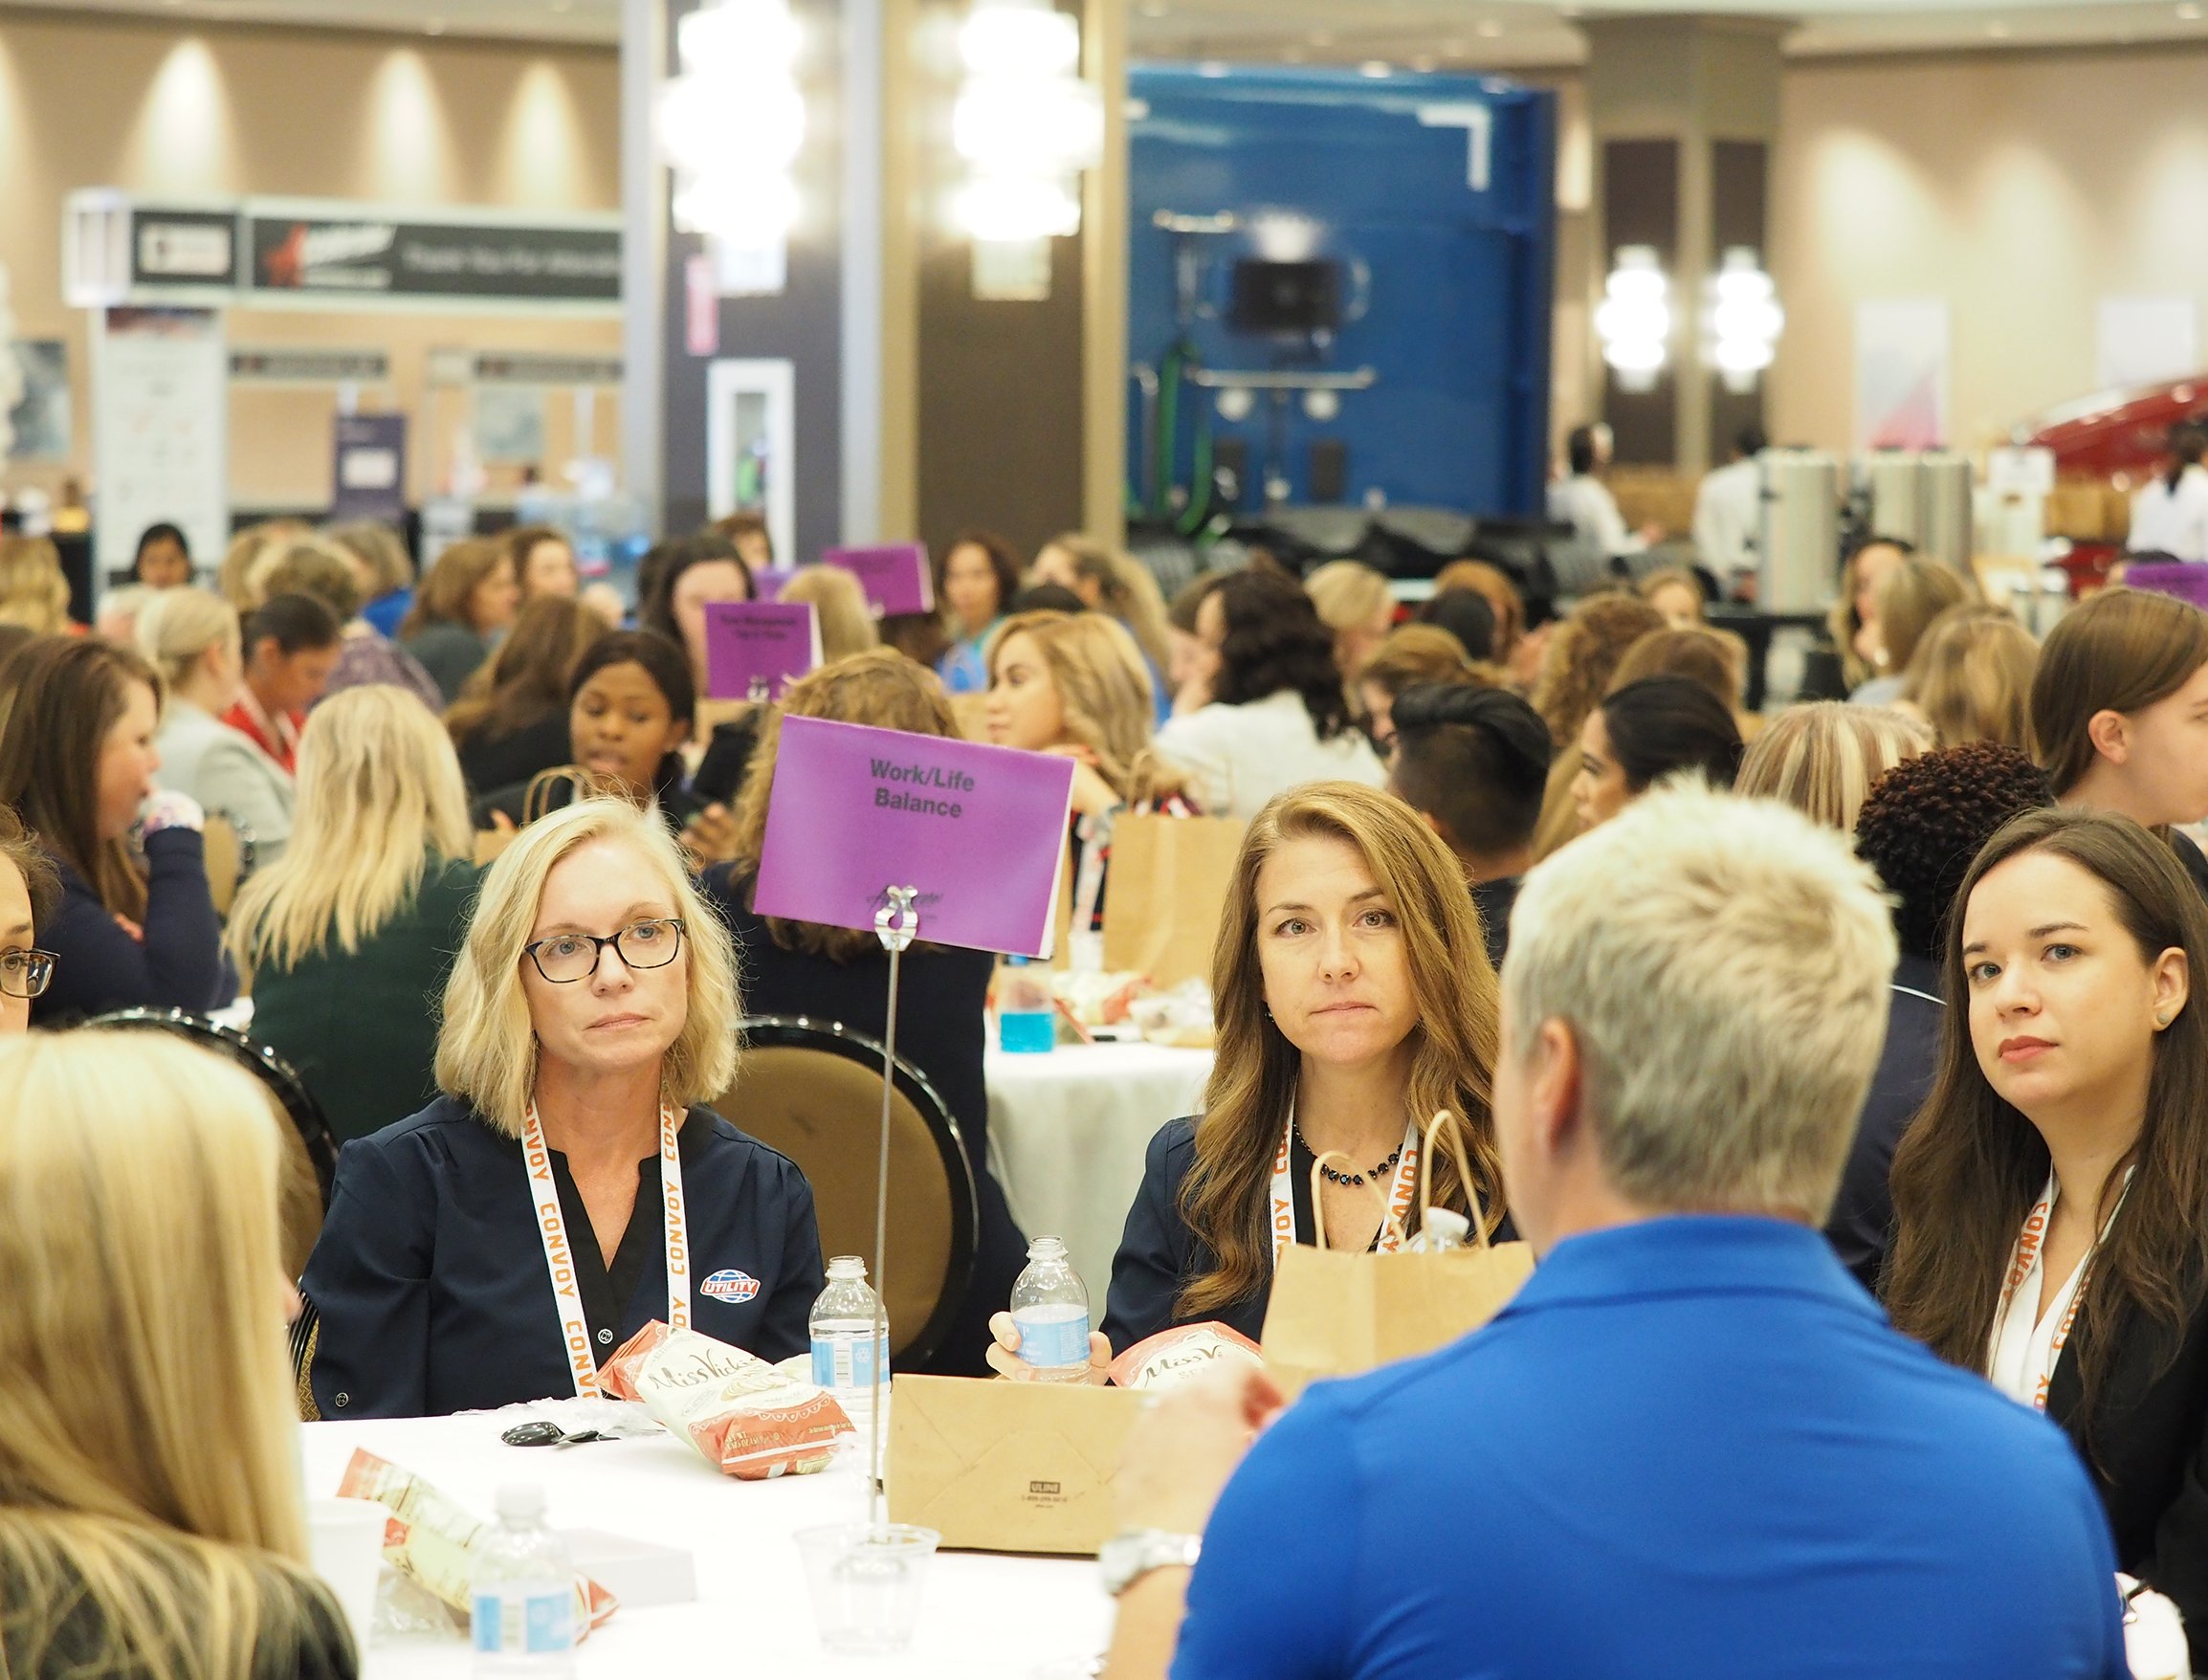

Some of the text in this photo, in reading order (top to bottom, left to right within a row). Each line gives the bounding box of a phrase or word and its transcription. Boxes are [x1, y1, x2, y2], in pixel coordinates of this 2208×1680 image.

[871, 759, 974, 792] Work/Life
[874, 787, 961, 818] Balance
[666, 1181, 686, 1275] CONVOY
[540, 1202, 576, 1297] CONVOY
[704, 1281, 757, 1293] UTILITY
[647, 1366, 709, 1390] Miss
